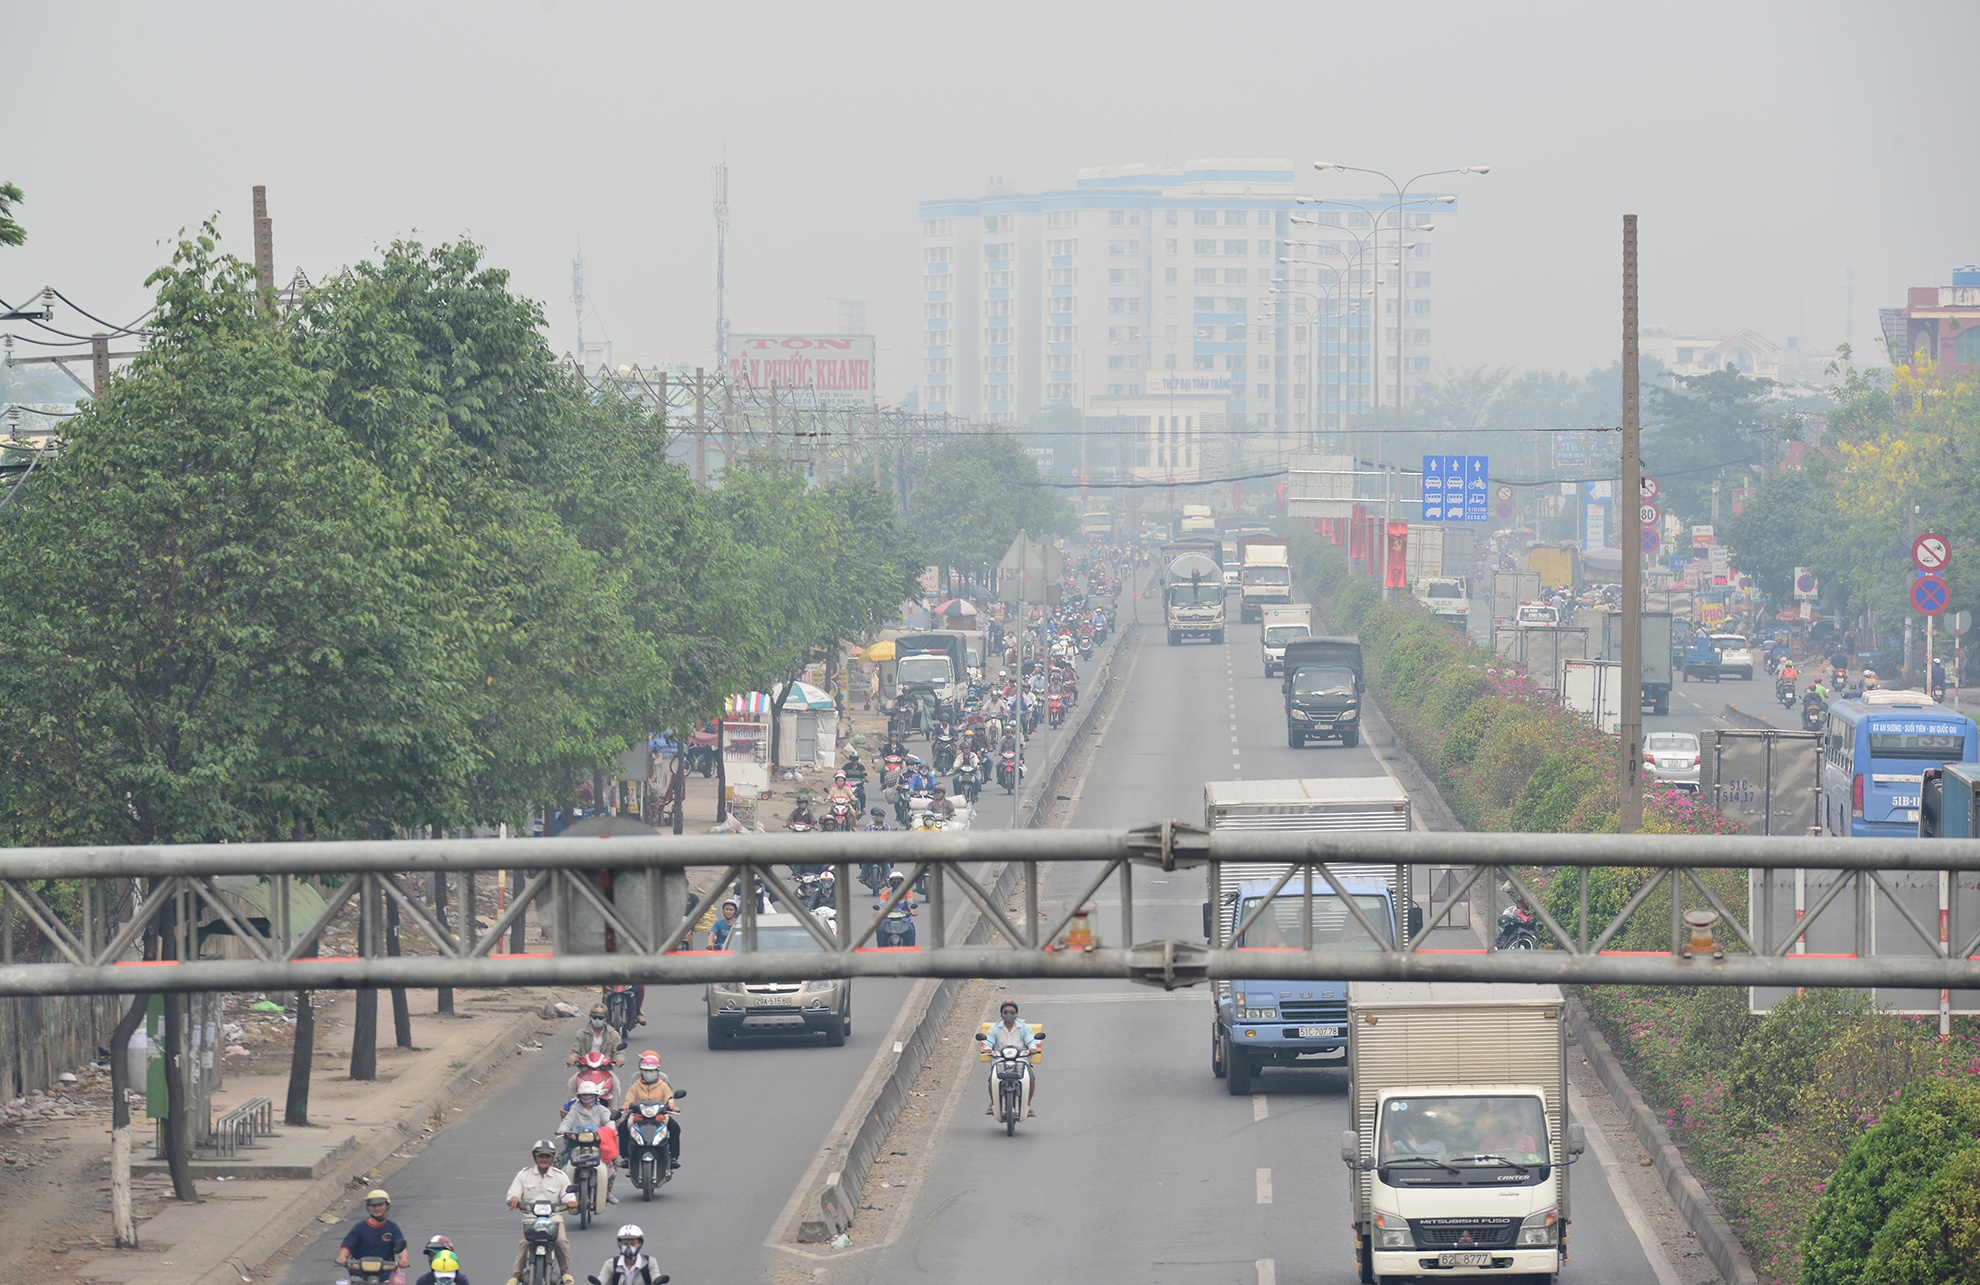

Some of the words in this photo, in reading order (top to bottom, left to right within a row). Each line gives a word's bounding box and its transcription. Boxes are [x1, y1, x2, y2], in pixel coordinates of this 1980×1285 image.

[815, 359, 870, 391] KHANH
[1641, 509, 1653, 520] 80
[1880, 723, 1886, 732] AN
[1729, 779, 1752, 791] 51C-
[1722, 791, 1755, 803] 514.17
[1280, 991, 1347, 999] FUS
